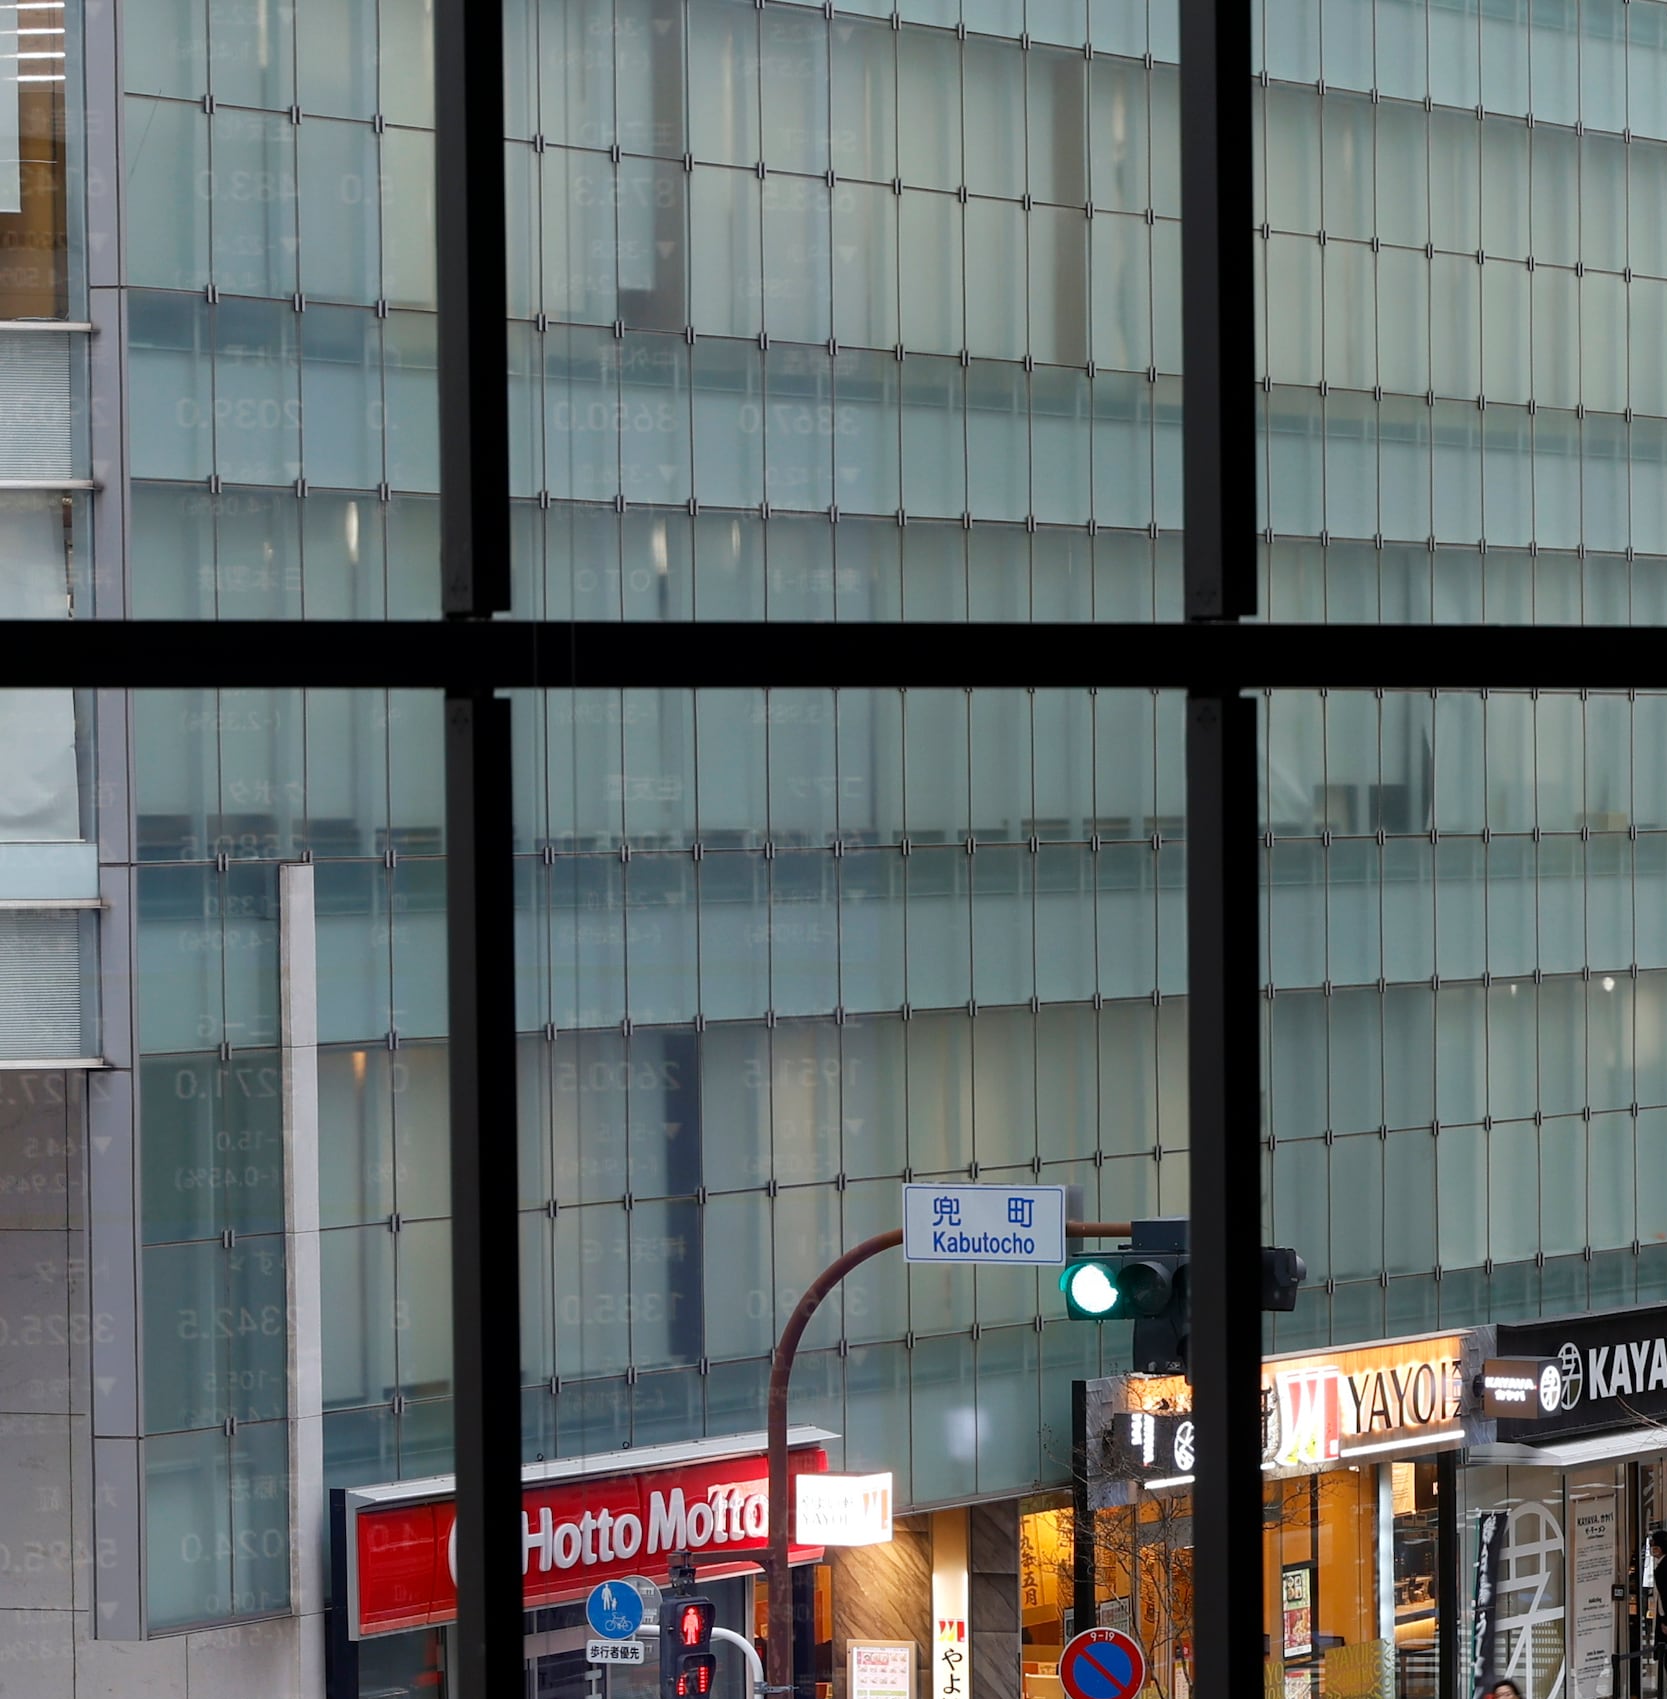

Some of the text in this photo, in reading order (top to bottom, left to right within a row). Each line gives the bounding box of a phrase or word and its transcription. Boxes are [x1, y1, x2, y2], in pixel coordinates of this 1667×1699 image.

[933, 1231, 1035, 1254] Kabutocho
[1348, 1362, 1447, 1434] YAYOI
[522, 1487, 769, 1575] Hotto Motto
[1090, 1631, 1115, 1642] 9-19
[590, 1645, 640, 1660] 歩行者優先
